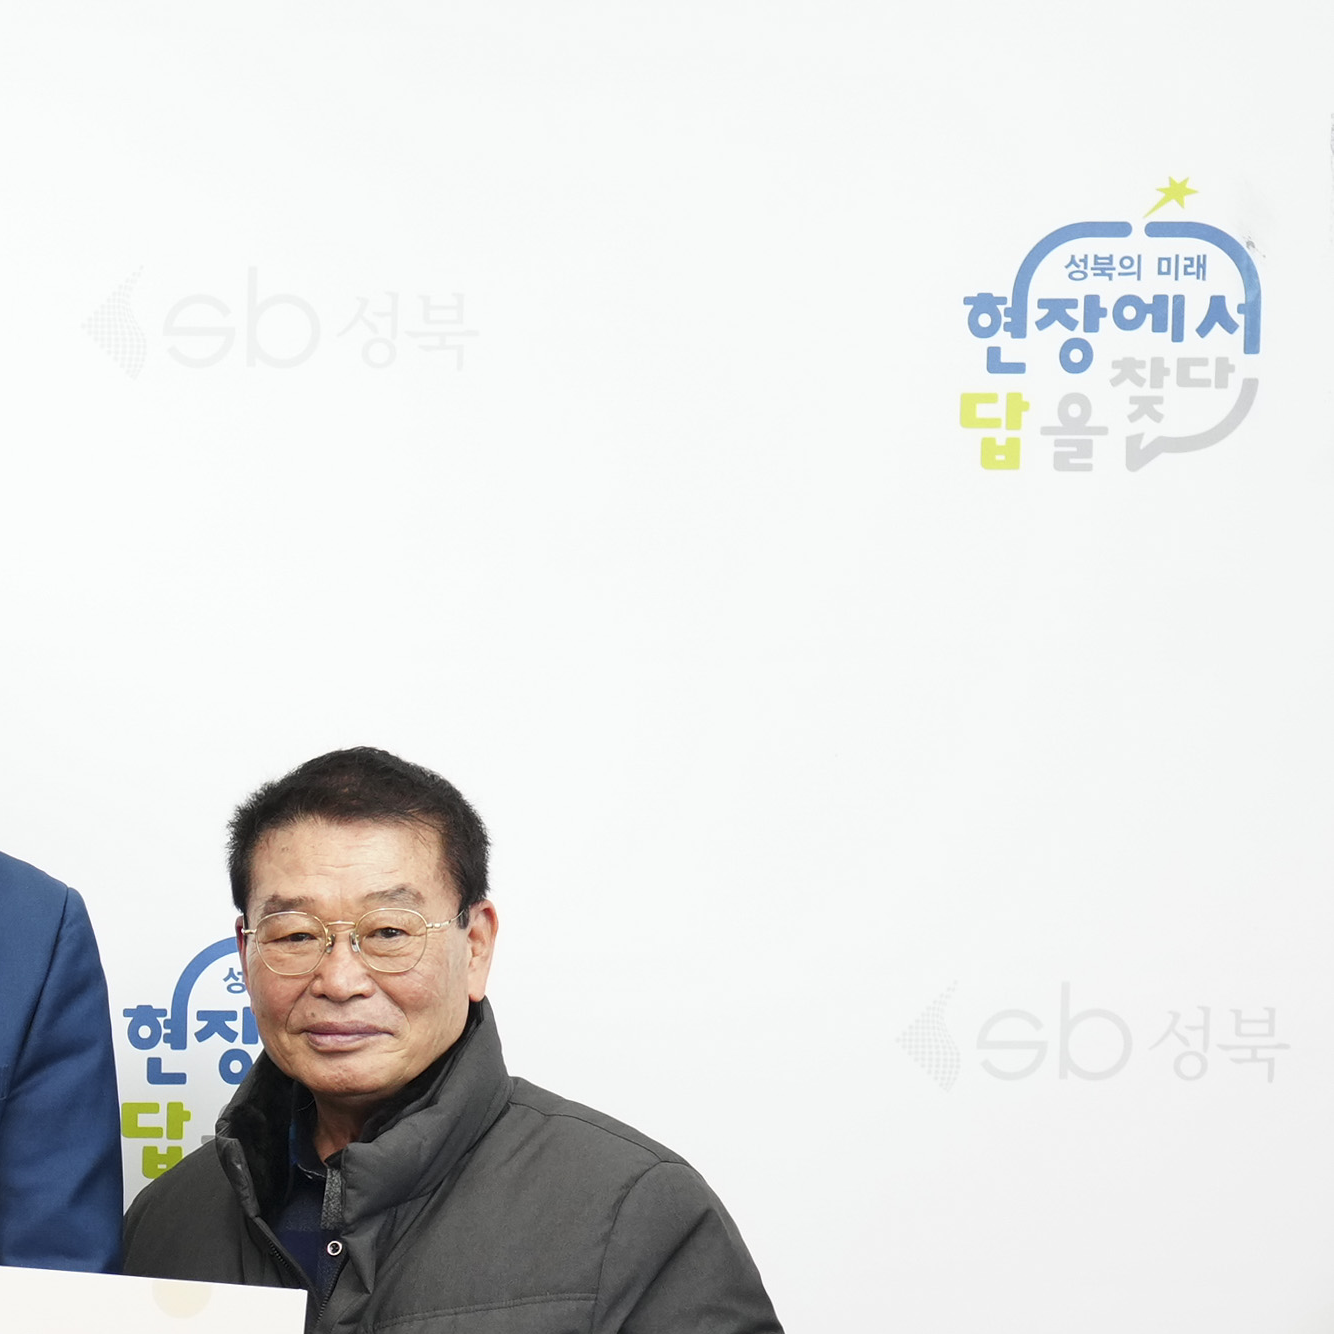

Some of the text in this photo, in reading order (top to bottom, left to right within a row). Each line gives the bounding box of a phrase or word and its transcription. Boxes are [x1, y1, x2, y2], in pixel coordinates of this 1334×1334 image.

[1064, 254, 1207, 281] 성북의 미래
[162, 266, 481, 371] sb 성북
[963, 293, 1262, 374] 현장에서
[123, 1005, 259, 1085] 현장
[976, 981, 1291, 1083] sb 성북
[121, 1101, 192, 1179] 답
